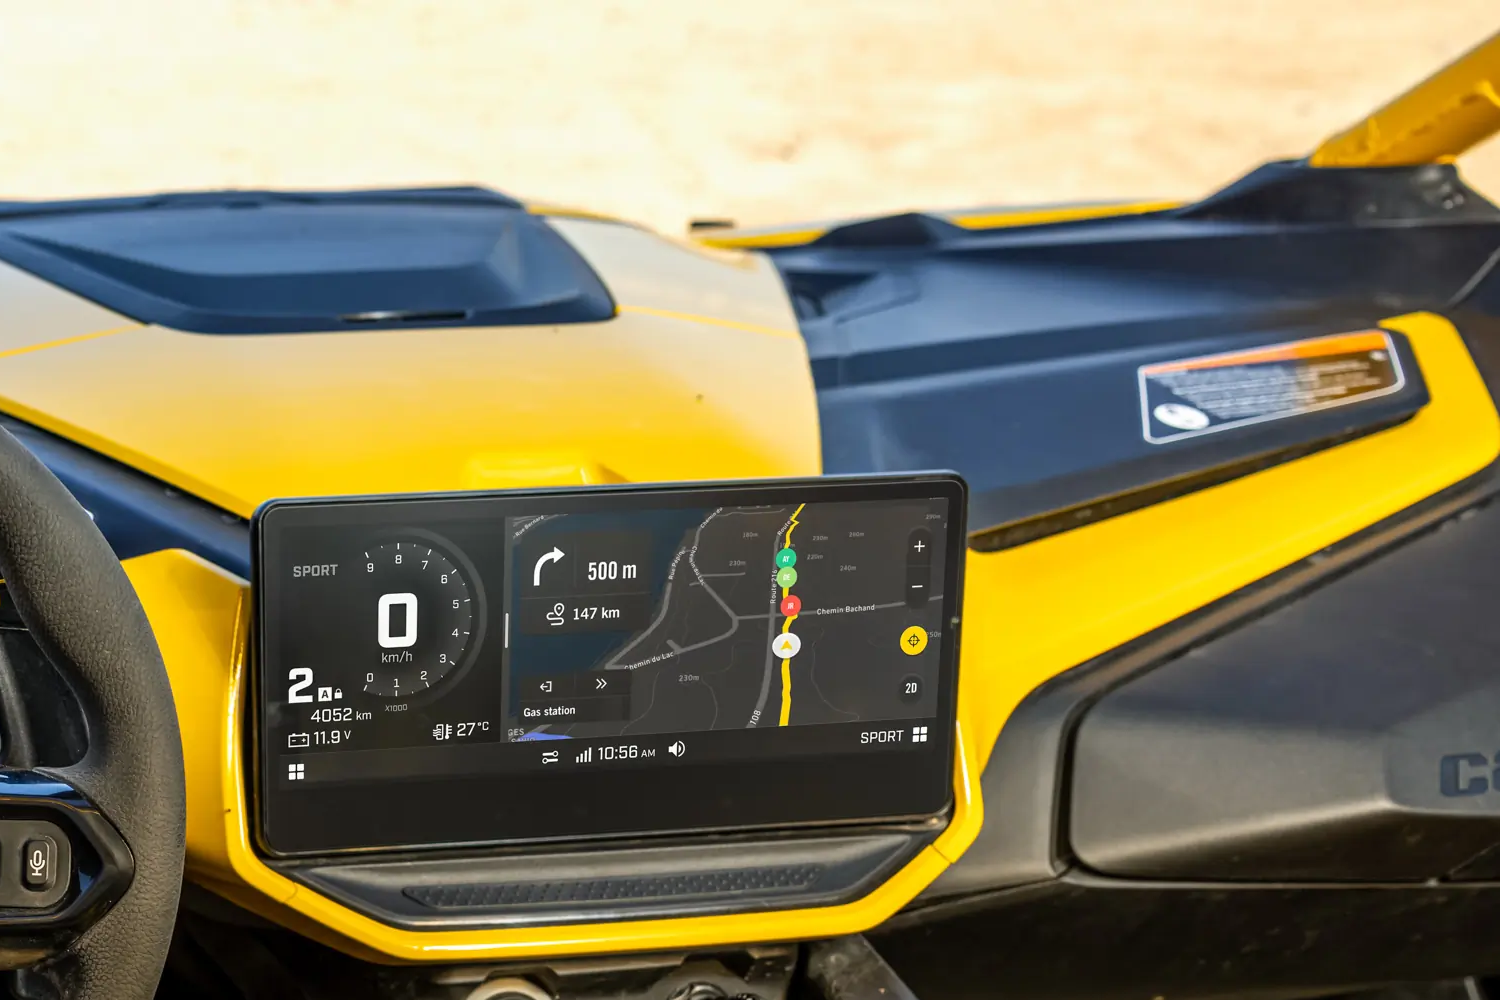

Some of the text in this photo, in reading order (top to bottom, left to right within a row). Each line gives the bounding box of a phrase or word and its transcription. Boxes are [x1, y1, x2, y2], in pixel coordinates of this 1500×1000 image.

[395, 555, 402, 564] 8
[421, 560, 428, 570] 7
[292, 564, 338, 578] SPORT
[366, 563, 374, 572] 9
[588, 561, 637, 580] 500 m
[441, 574, 448, 584] 6
[452, 600, 459, 609] 5
[816, 604, 875, 615] Chemin Bachand
[573, 607, 620, 620] 147 km
[378, 592, 418, 648] 0
[452, 628, 459, 638] 4
[381, 651, 413, 663] km/h
[439, 654, 446, 663] 3
[662, 651, 674, 660] Lac
[367, 672, 374, 682] 0
[420, 671, 427, 680] 2
[288, 667, 314, 704] 2
[394, 679, 400, 688] 1
[905, 683, 917, 694] 2D
[310, 708, 372, 722] 4052 km
[523, 706, 576, 717] Gas station
[313, 730, 351, 745] 11.9 V
[860, 730, 904, 744] SPORT
[598, 745, 656, 760] 10:56 AM
